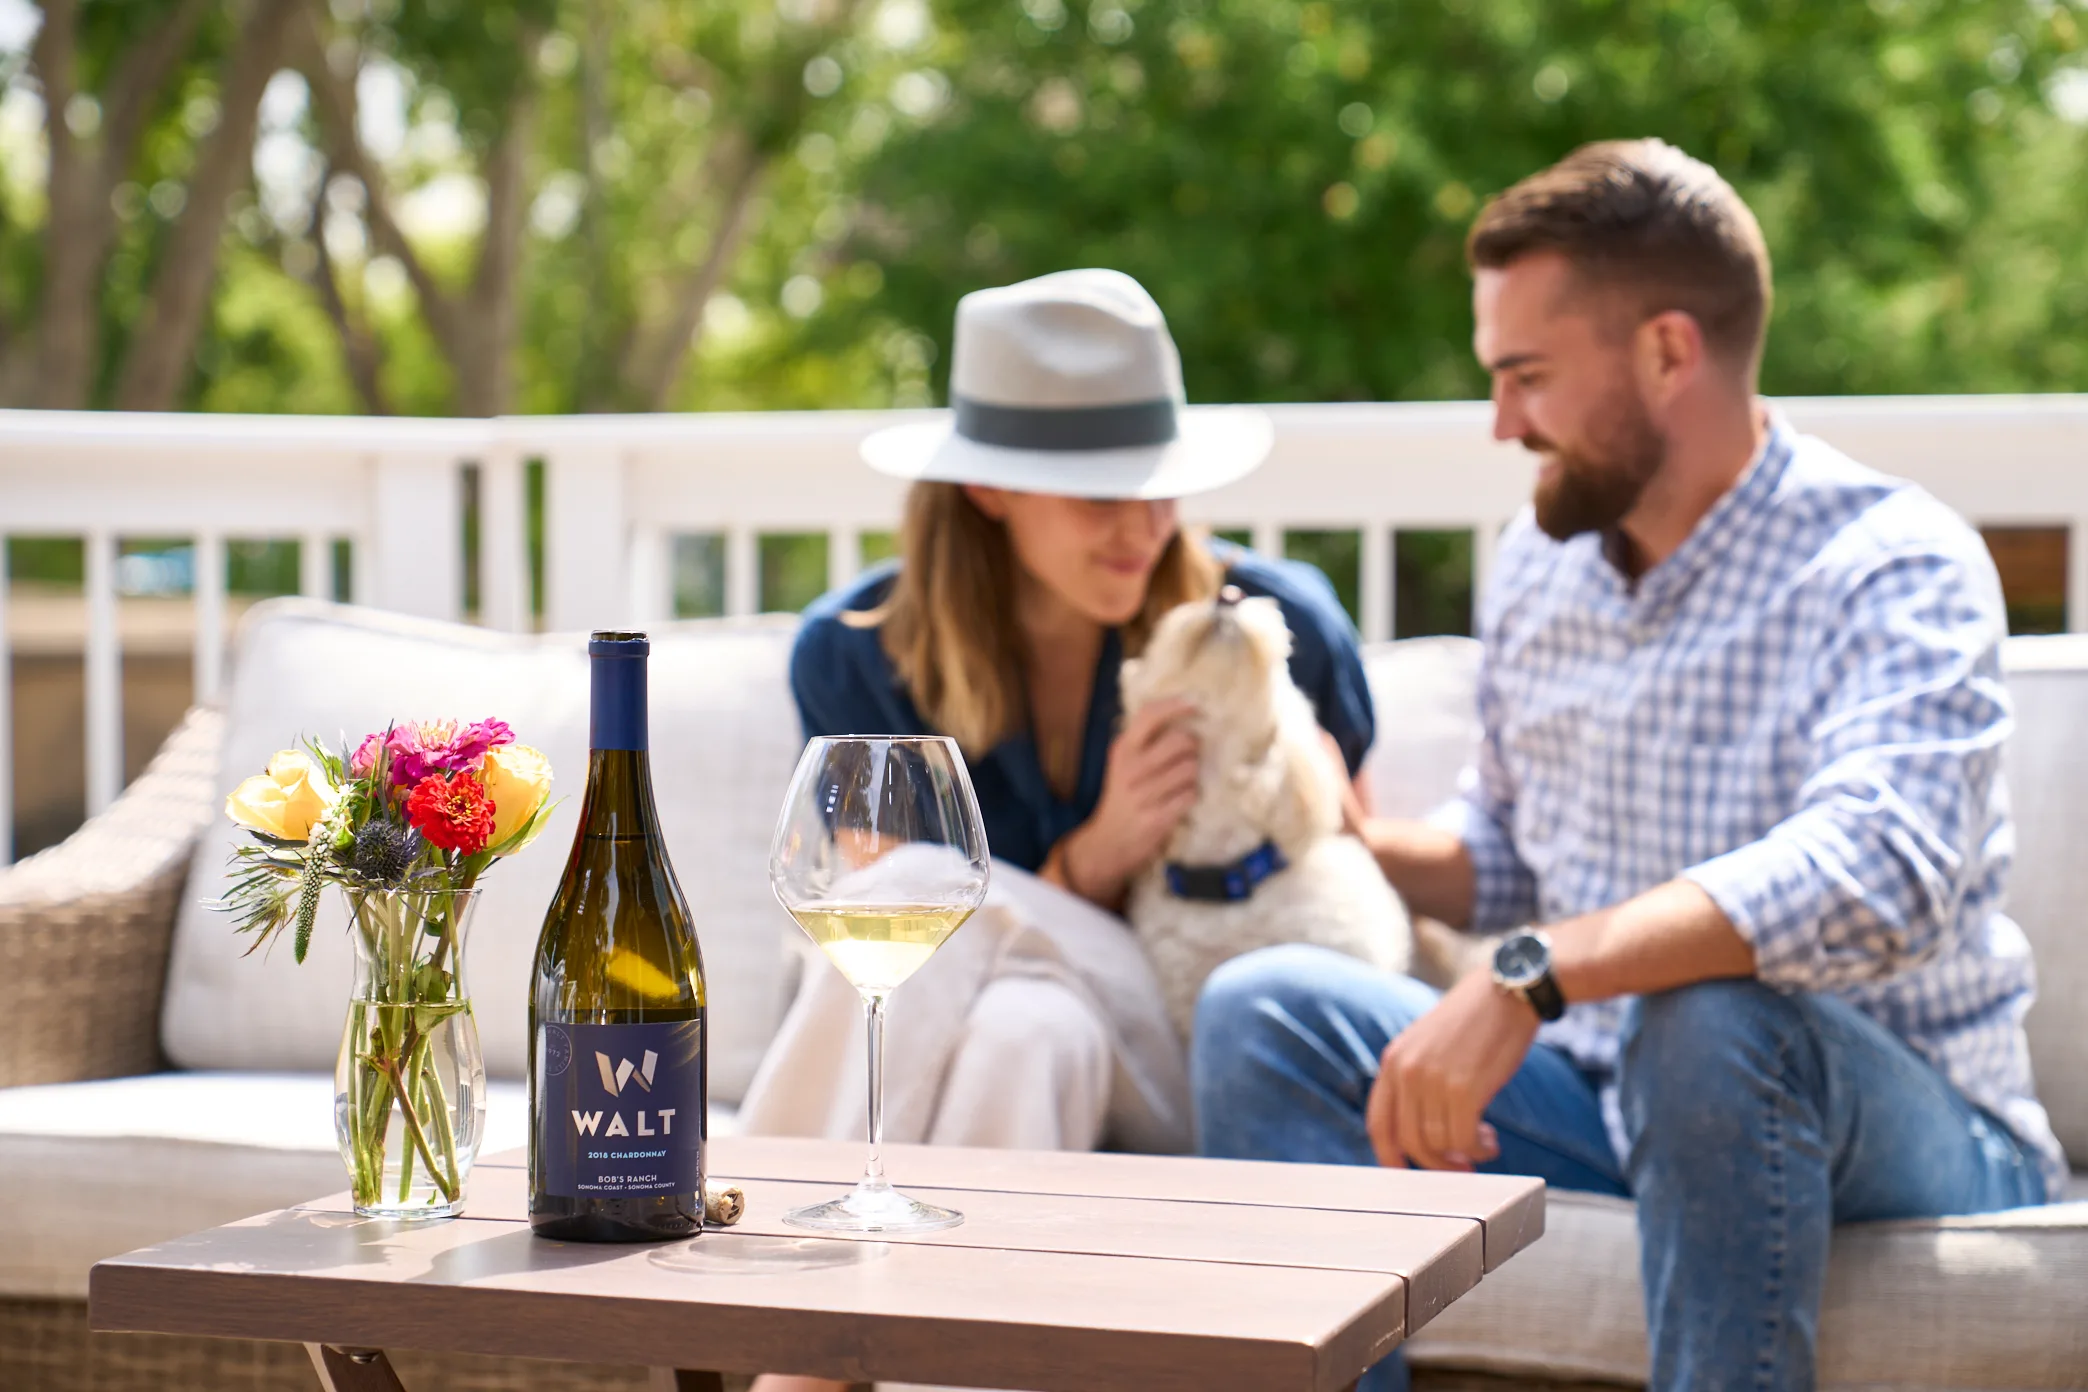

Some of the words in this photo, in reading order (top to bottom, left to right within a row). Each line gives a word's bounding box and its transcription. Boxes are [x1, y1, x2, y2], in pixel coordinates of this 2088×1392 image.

[594, 1048, 659, 1099] W
[571, 1108, 676, 1137] WALT
[587, 1151, 609, 1159] 2018
[611, 1150, 666, 1159] CHARDONNAY
[598, 1175, 624, 1183] BOB'S
[627, 1174, 657, 1182] RANCH
